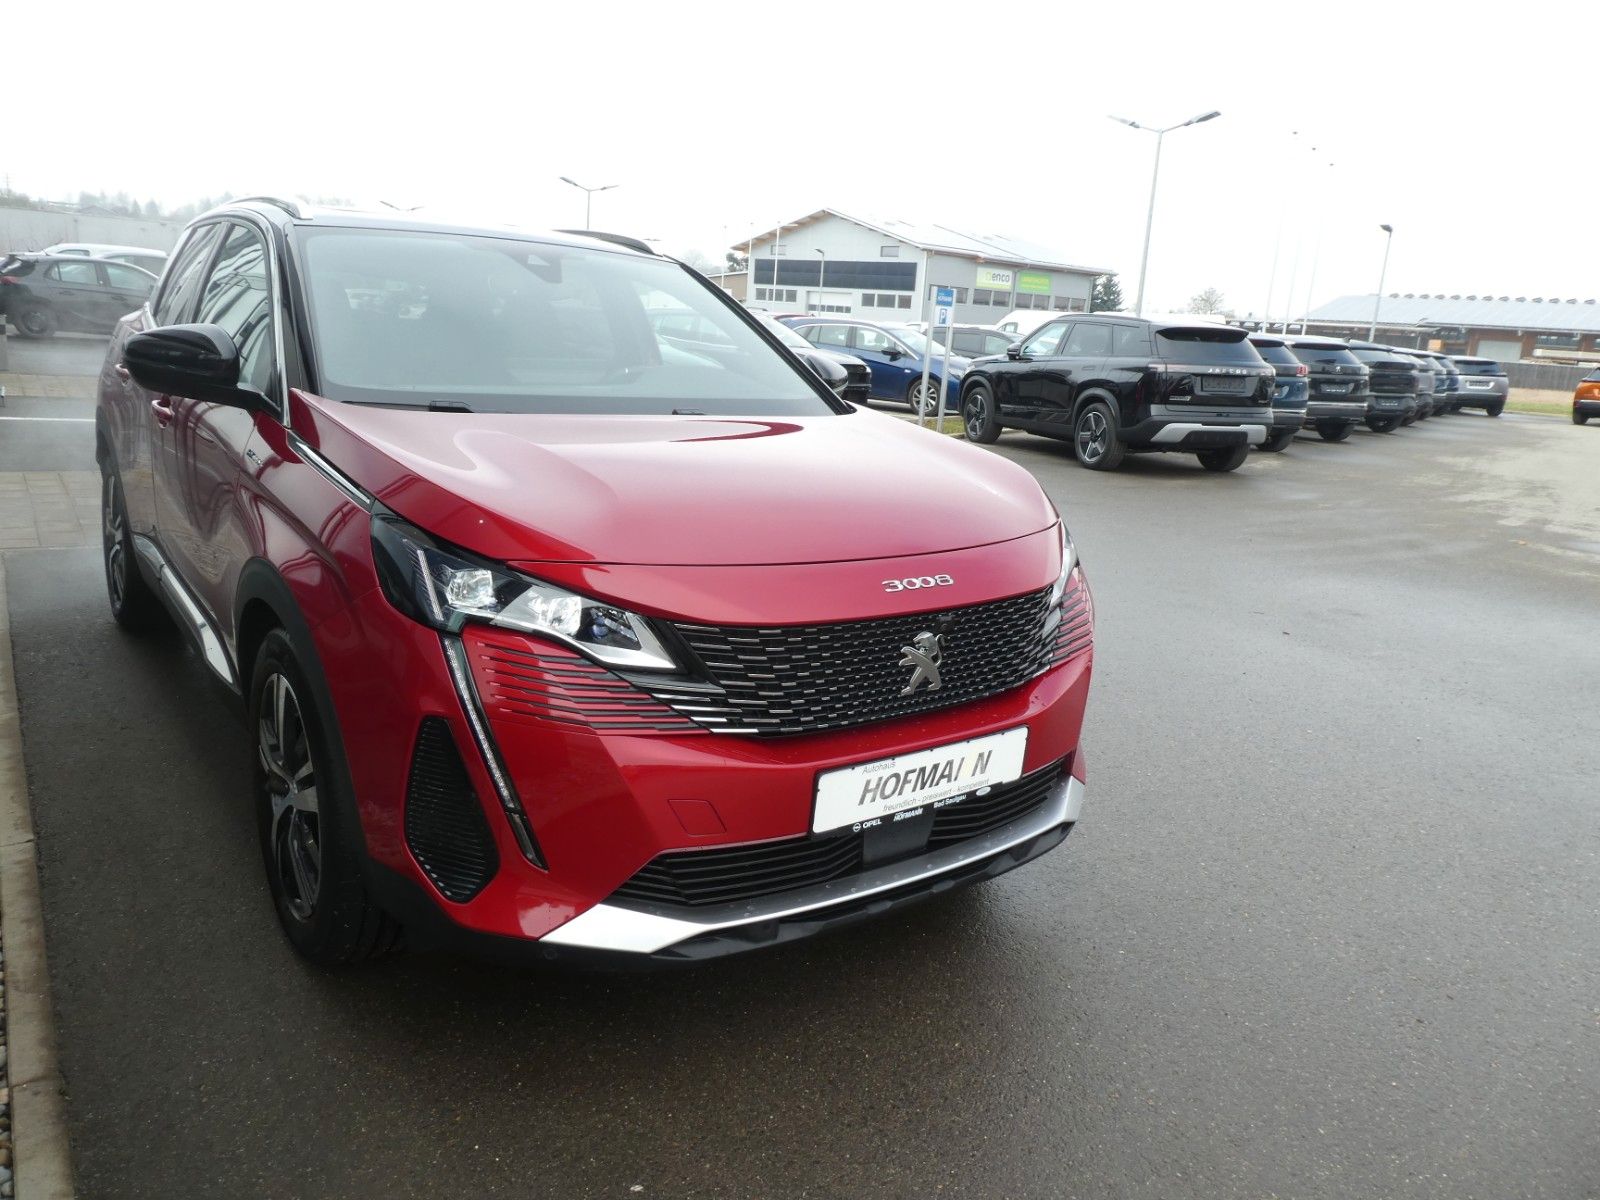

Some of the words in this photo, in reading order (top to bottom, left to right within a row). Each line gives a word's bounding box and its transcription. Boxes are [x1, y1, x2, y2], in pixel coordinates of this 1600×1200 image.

[882, 574, 954, 592] 3008
[862, 760, 897, 775] Autohaus
[862, 818, 883, 829] OPEL
